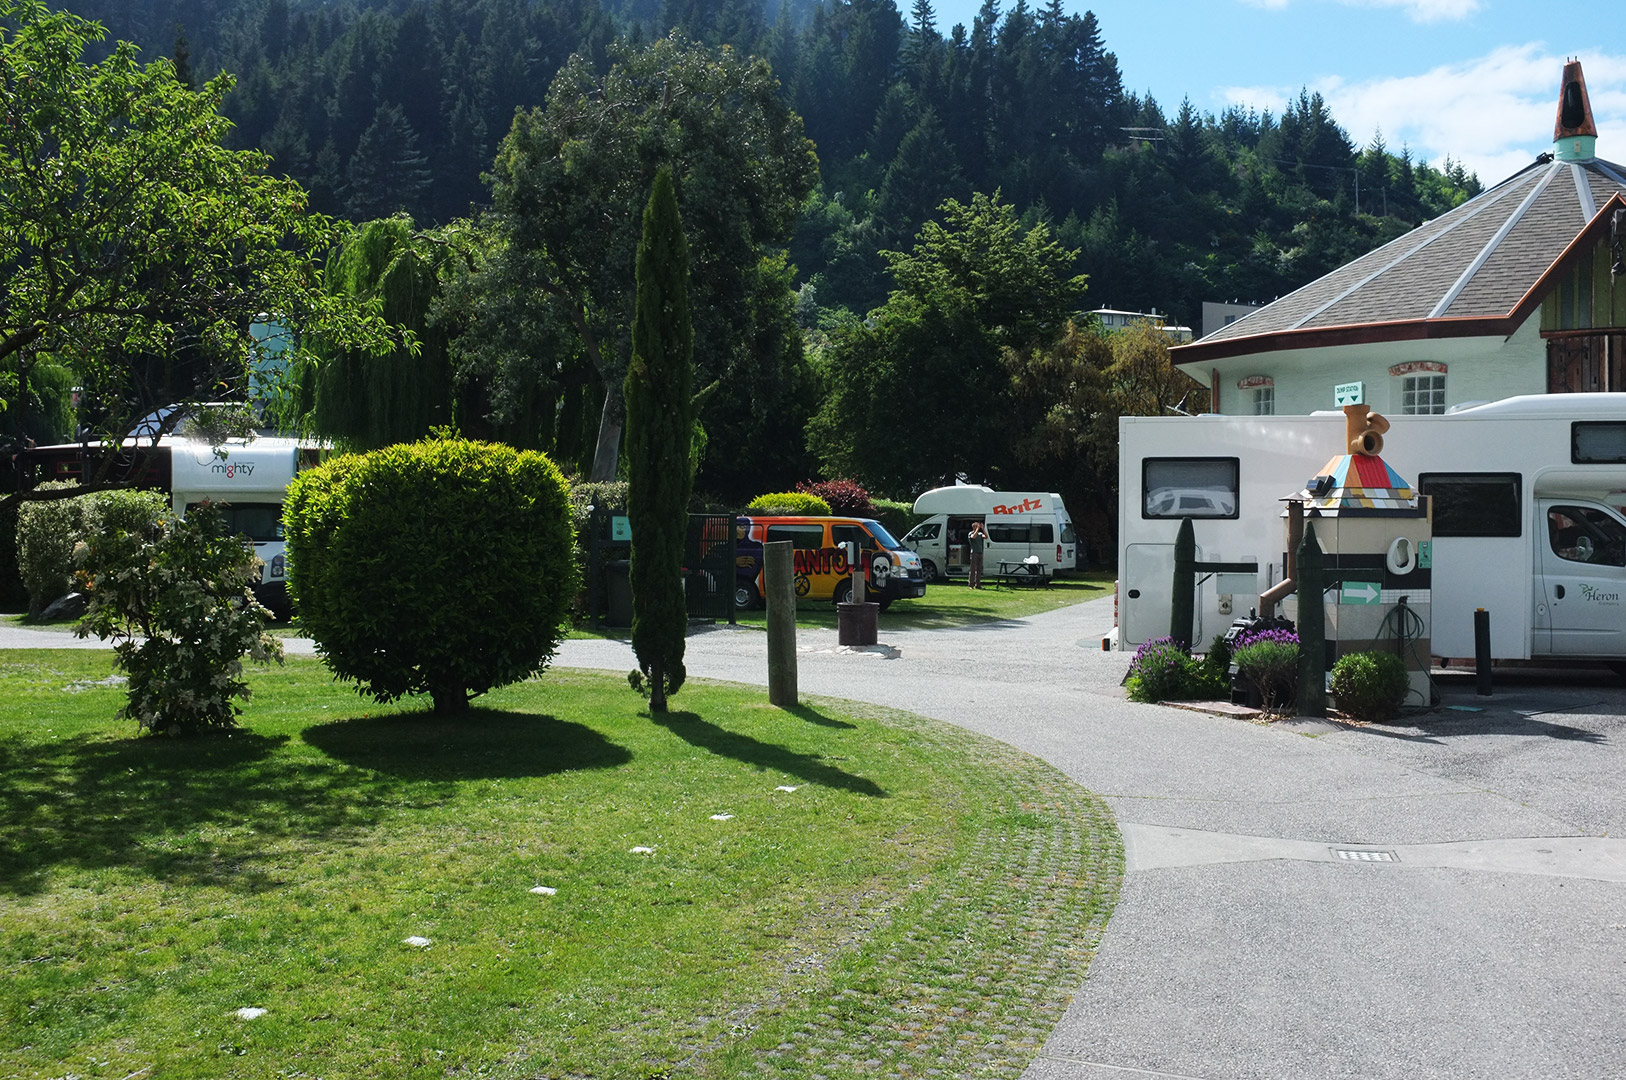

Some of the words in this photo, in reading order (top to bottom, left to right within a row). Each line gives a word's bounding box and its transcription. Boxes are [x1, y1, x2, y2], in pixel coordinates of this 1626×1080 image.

[211, 462, 255, 479] mighty
[993, 498, 1043, 515] Britz
[1585, 588, 1619, 601] Heron
